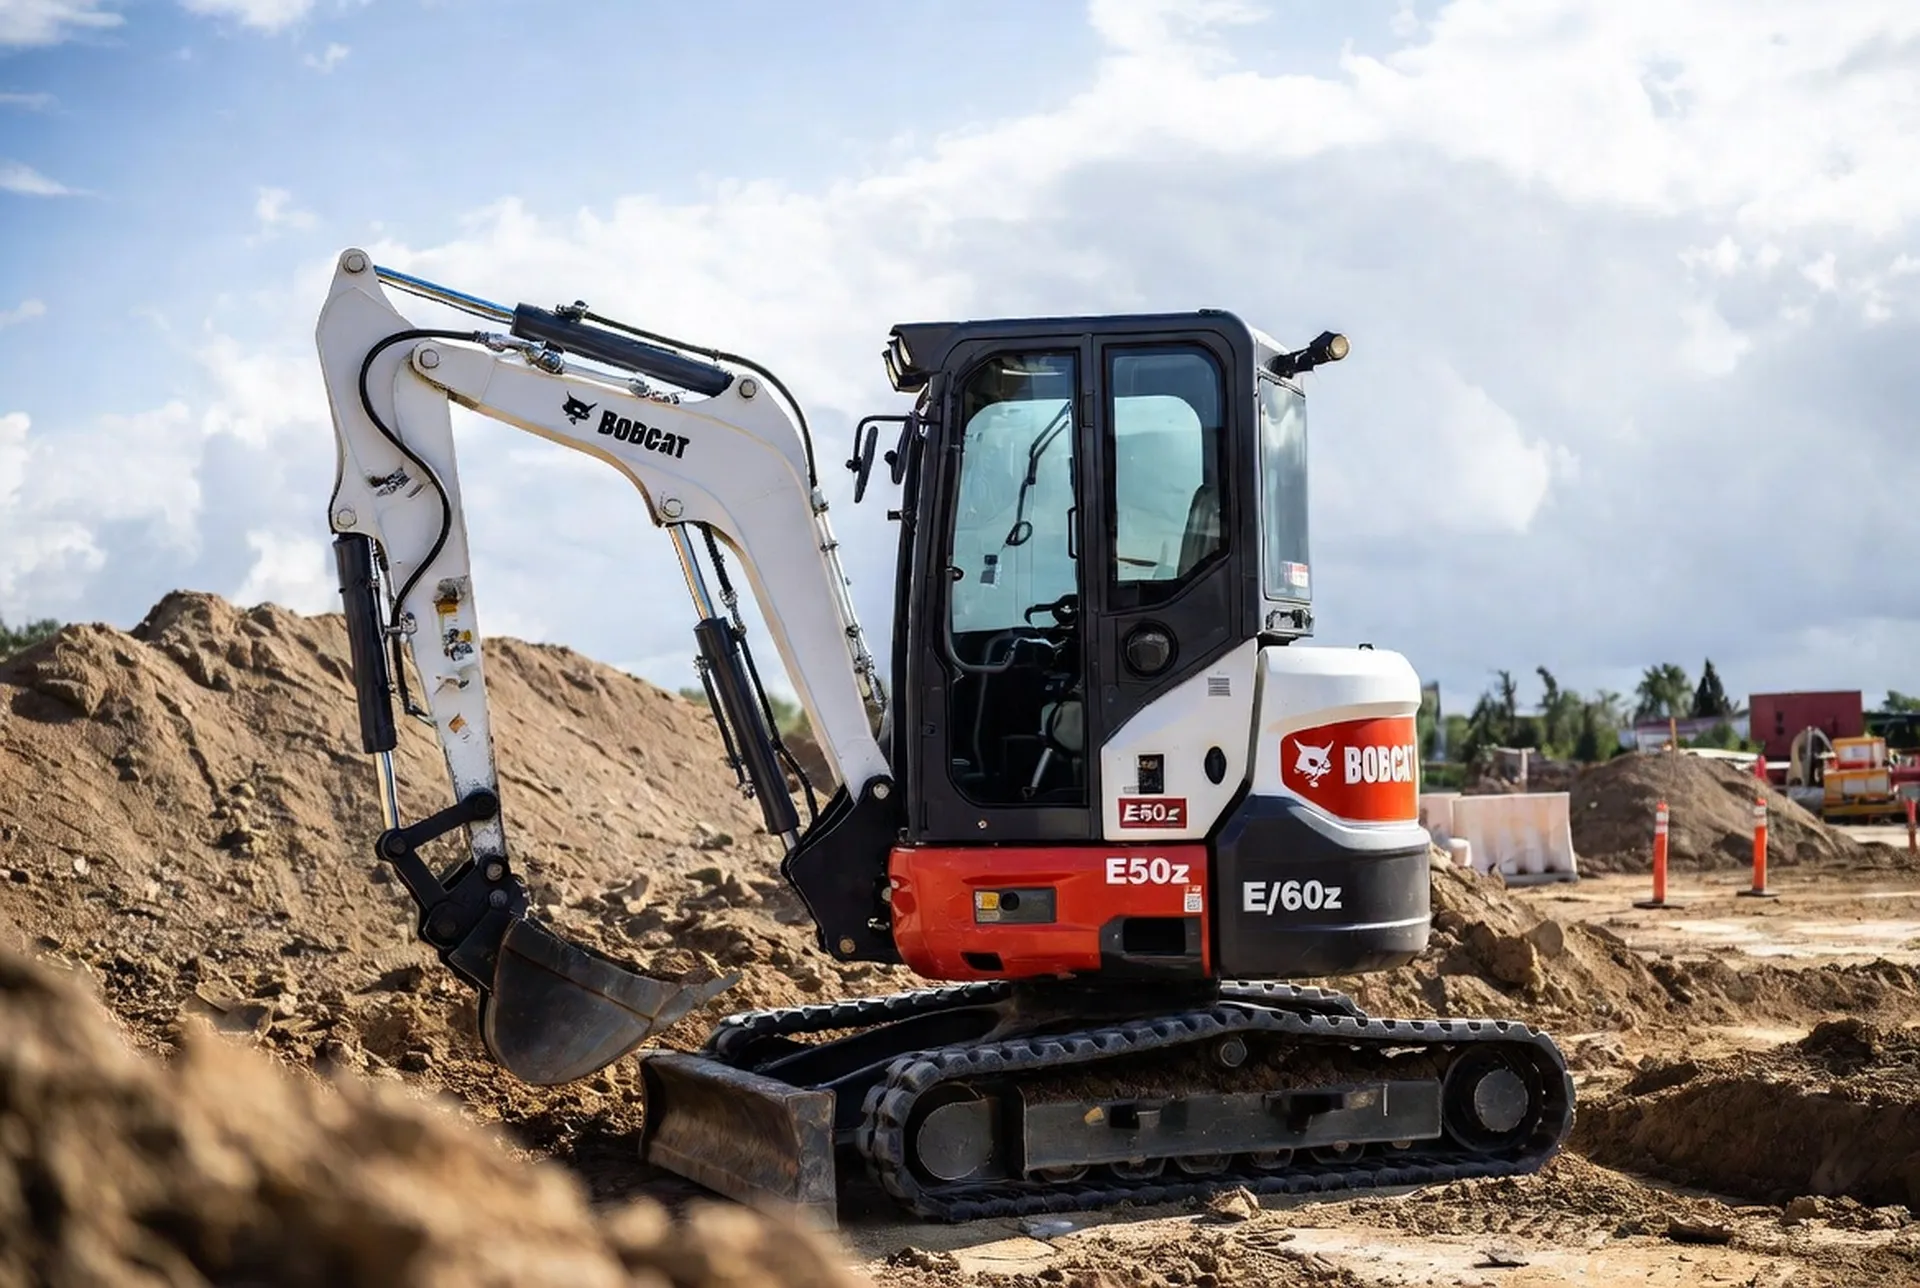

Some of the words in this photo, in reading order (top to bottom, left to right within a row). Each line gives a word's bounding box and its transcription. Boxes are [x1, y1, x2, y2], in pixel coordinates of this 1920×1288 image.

[598, 411, 690, 458] BOBCAT
[1106, 858, 1190, 885] E50z
[1243, 880, 1342, 915] E/60z
